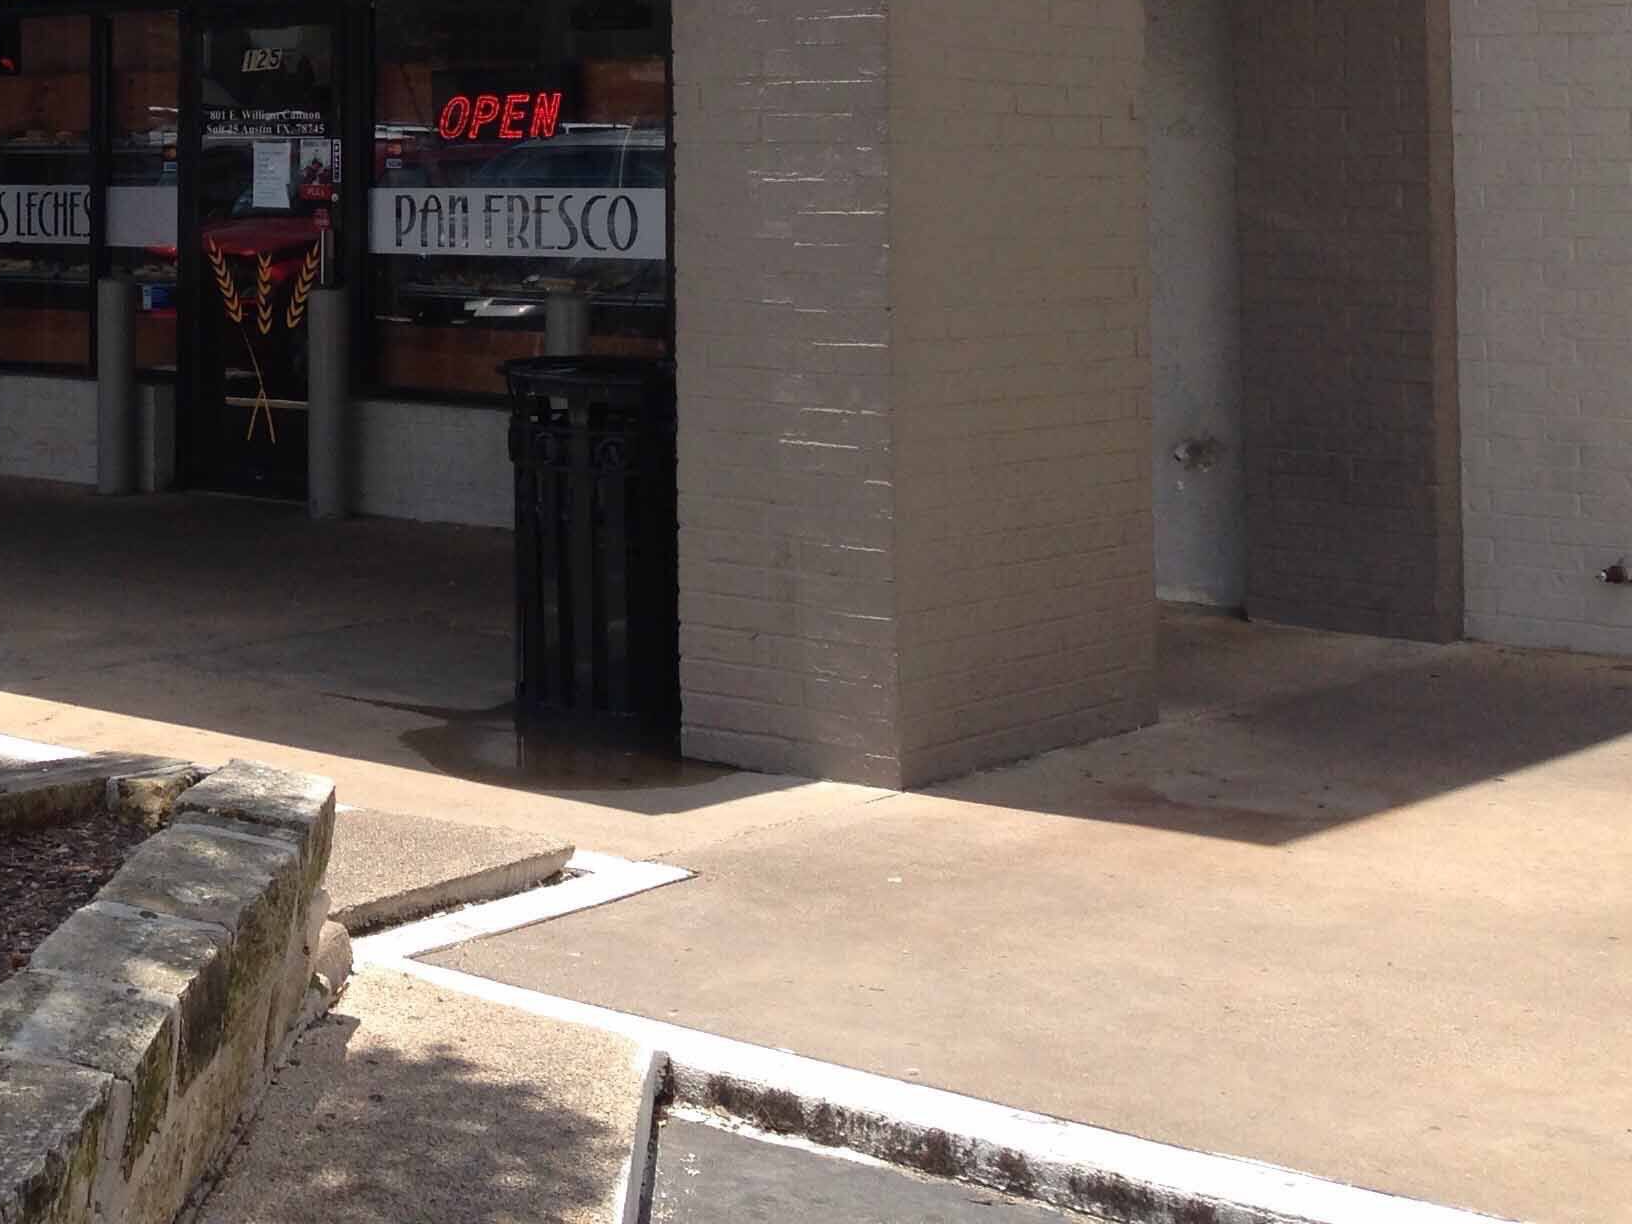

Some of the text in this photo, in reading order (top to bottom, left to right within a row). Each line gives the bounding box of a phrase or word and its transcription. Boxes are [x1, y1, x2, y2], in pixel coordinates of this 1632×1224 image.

[242, 48, 283, 73] 125
[438, 92, 561, 139] OPEN
[11, 191, 91, 238] LECHES
[393, 193, 639, 252] PAN FRESCO
